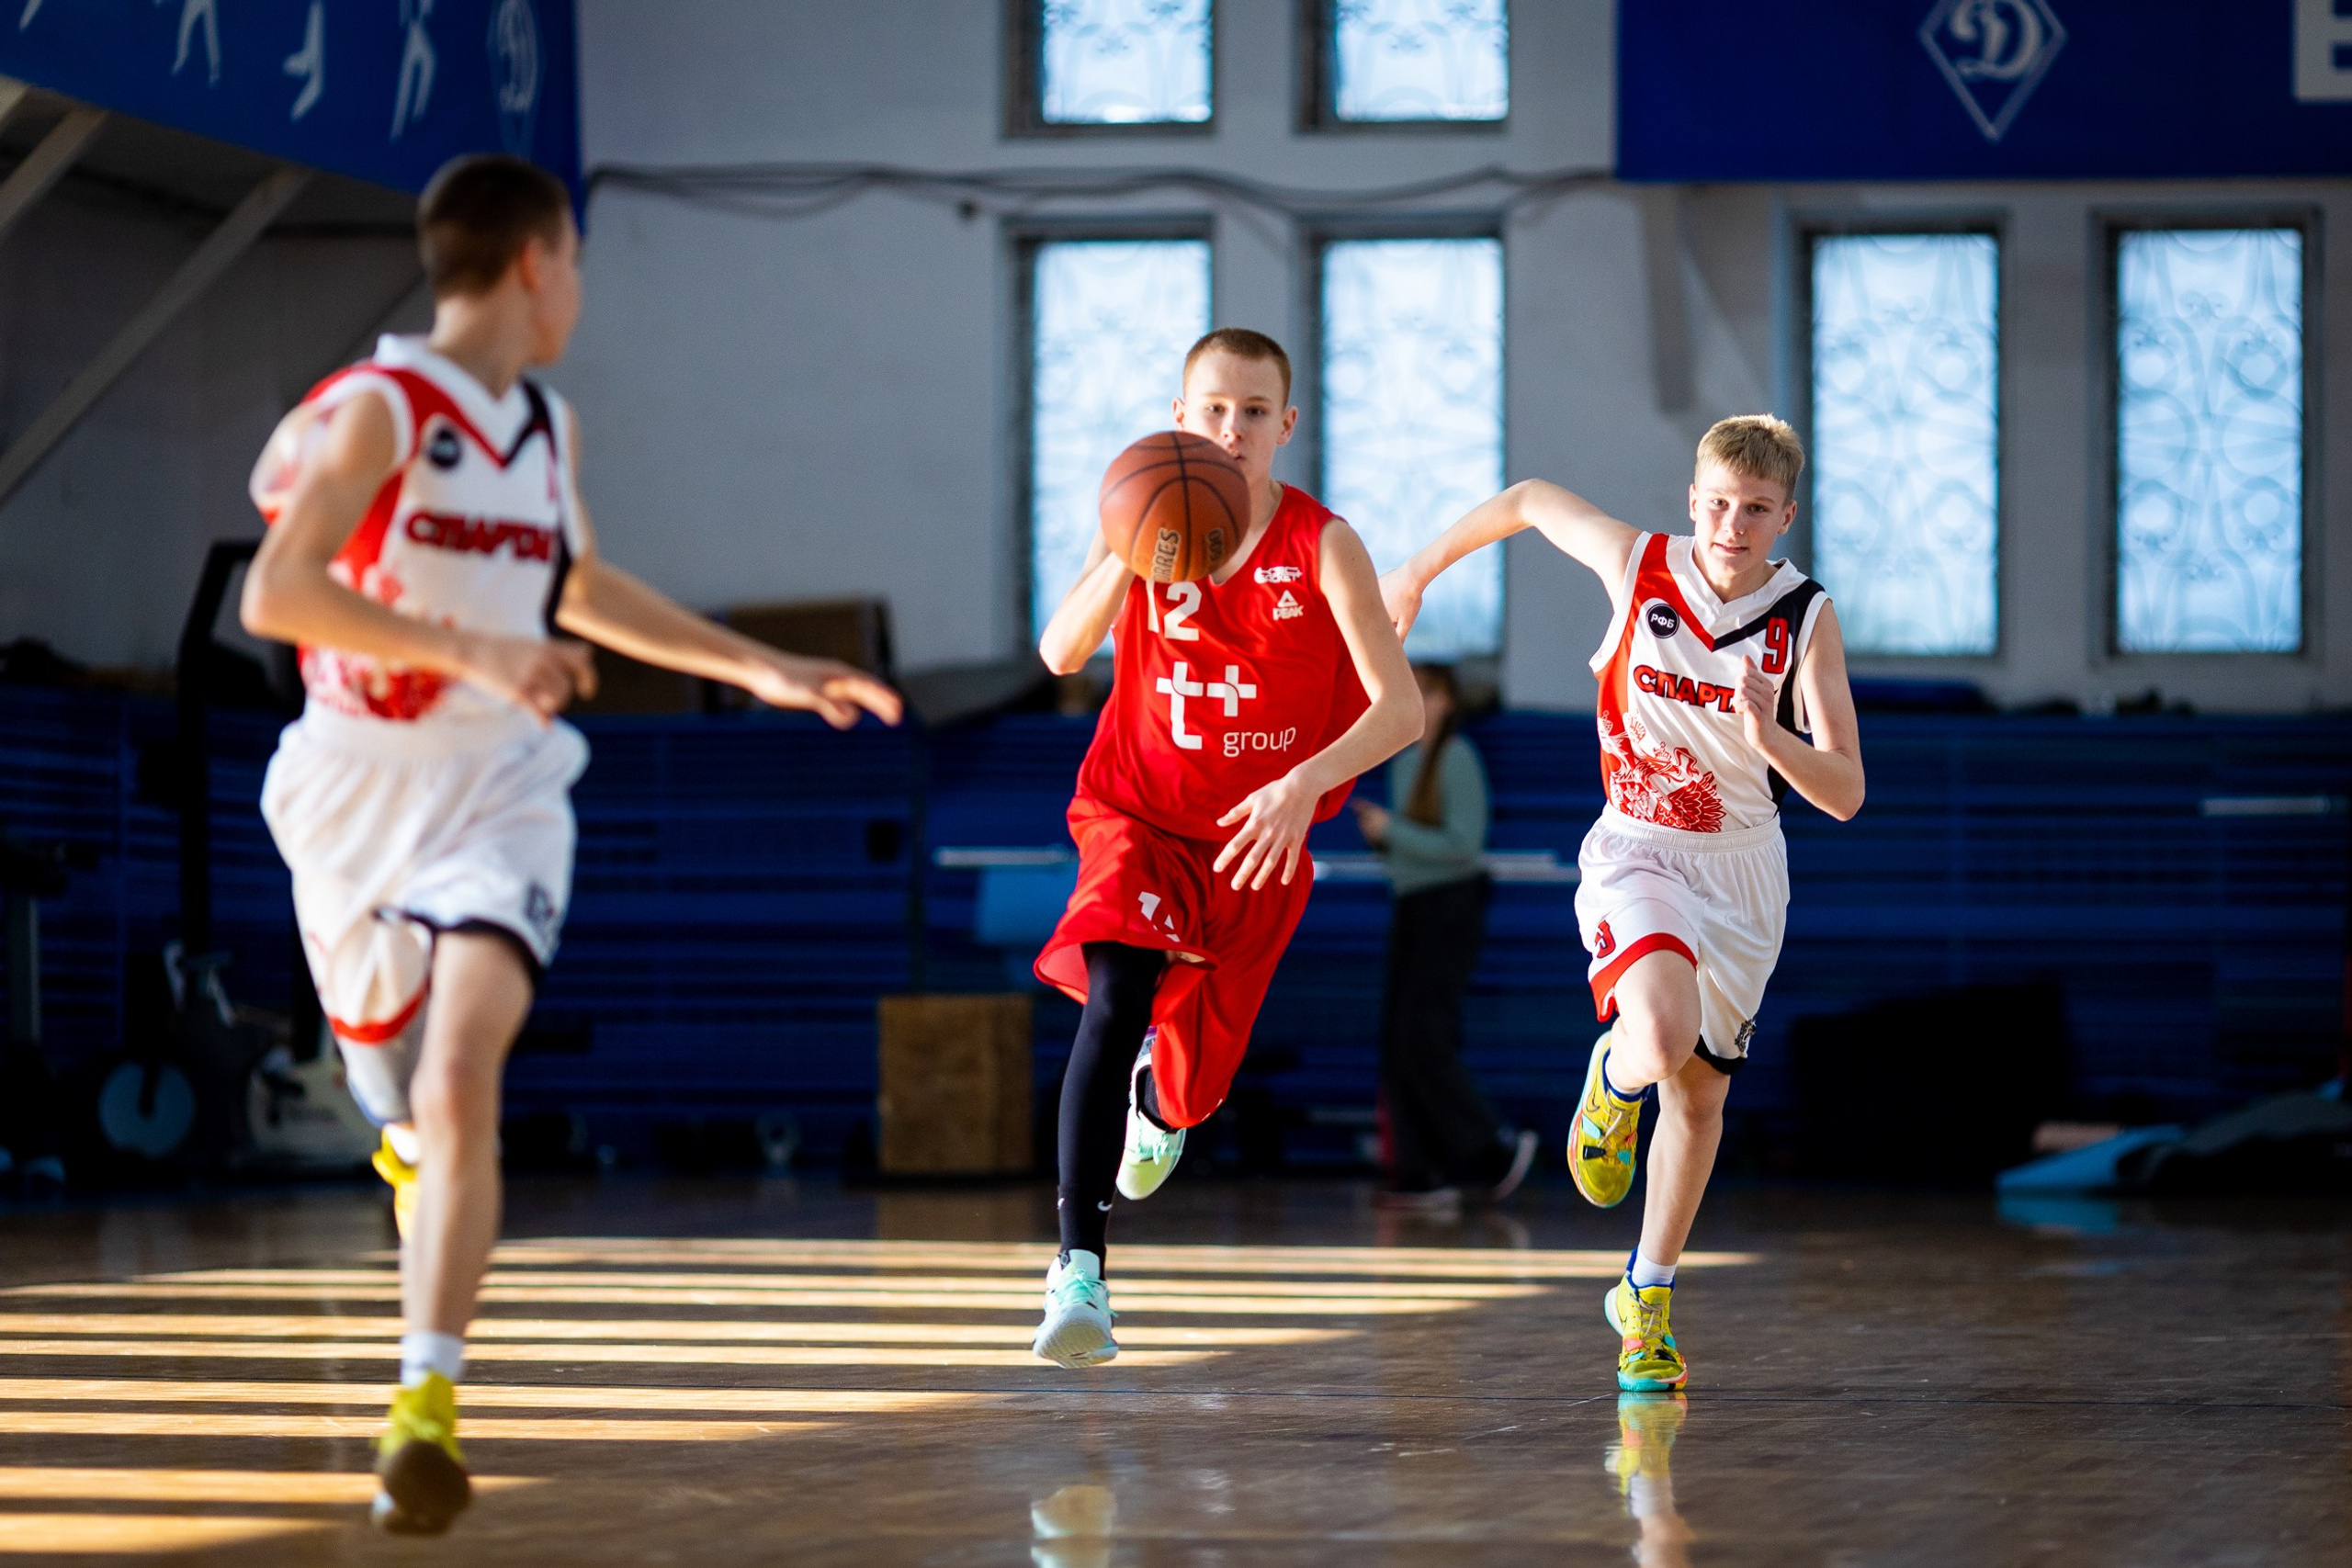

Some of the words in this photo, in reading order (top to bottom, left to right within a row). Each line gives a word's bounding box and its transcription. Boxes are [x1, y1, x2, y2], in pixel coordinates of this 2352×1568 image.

[1146, 579, 1203, 641] 12
[1272, 605, 1304, 621] PEAK
[1650, 613, 1676, 629] РФБ
[1761, 616, 1789, 675] 9
[1633, 664, 1736, 714] СПАРТ
[1223, 727, 1296, 758] group
